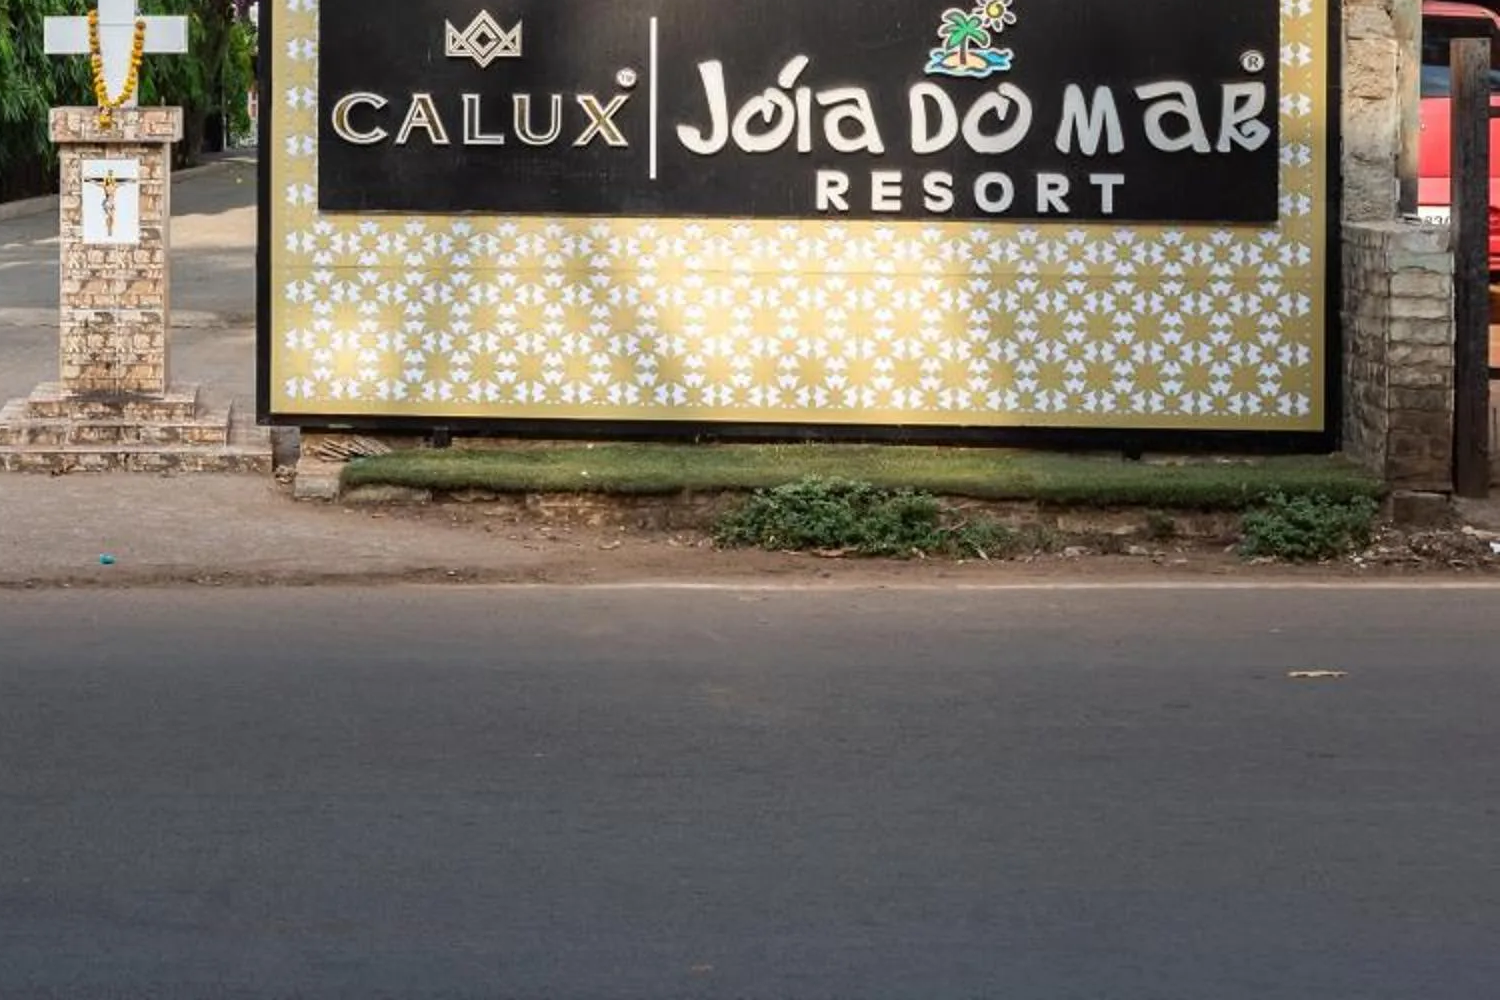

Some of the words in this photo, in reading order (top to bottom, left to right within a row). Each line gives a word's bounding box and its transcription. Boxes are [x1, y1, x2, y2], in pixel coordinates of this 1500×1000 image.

[331, 91, 631, 147] CALUX
[909, 80, 1033, 156] DO
[814, 171, 1126, 214] RESORT
